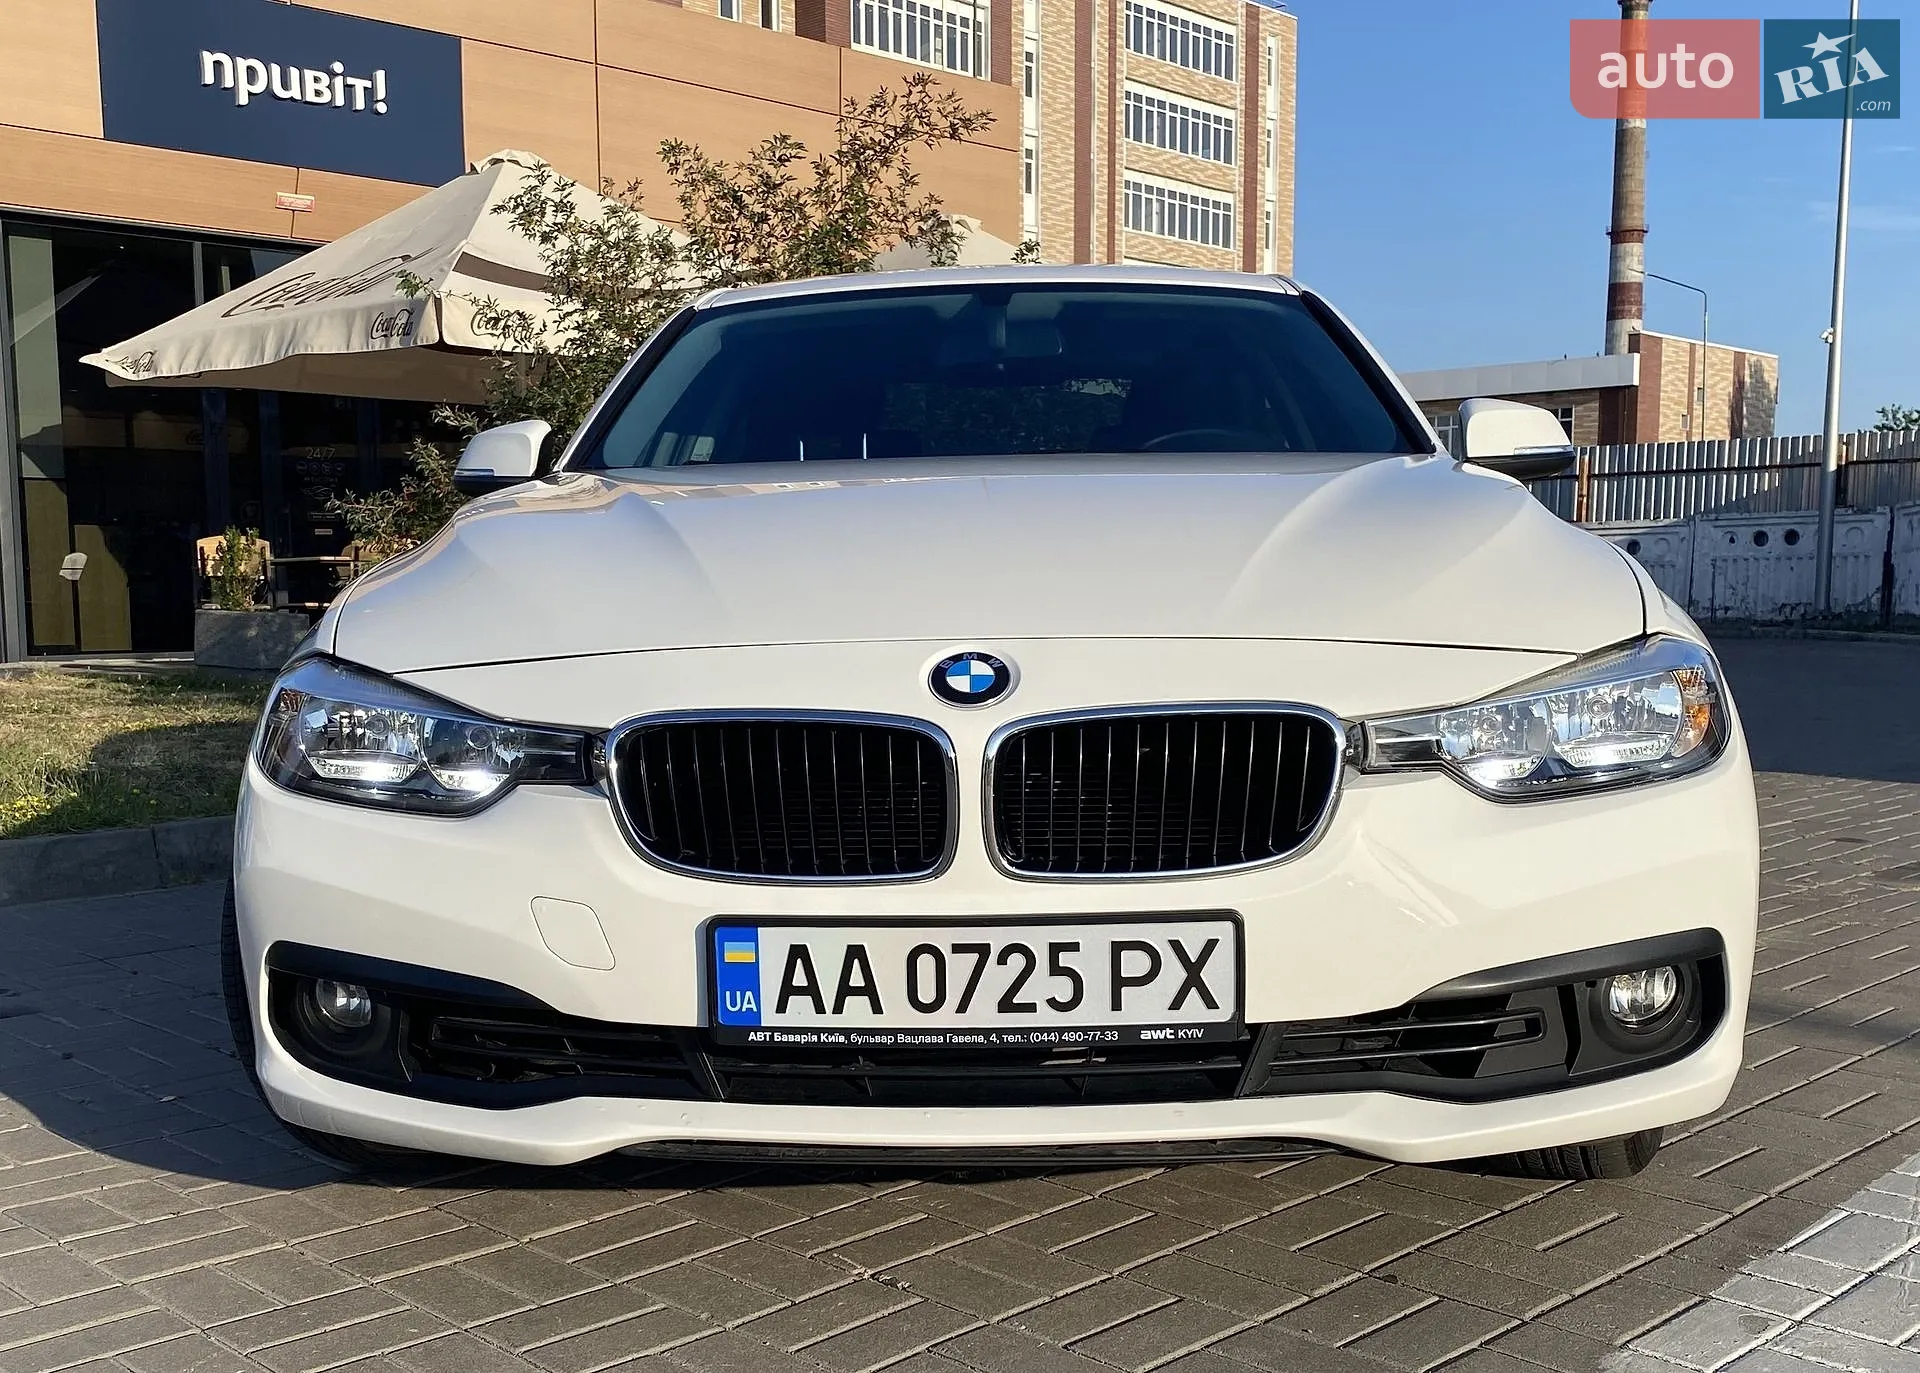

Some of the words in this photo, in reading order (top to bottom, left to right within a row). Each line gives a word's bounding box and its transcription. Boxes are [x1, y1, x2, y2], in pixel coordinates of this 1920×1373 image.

[201, 50, 388, 115] привіт!
[306, 448, 336, 460] 24/7
[939, 652, 1004, 669] BMW
[774, 943, 884, 1016] AA
[905, 942, 1084, 1015] 0725
[1109, 938, 1221, 1012] PX
[725, 990, 757, 1013] UA
[748, 1031, 771, 1042] АВТ
[774, 1032, 817, 1044] Баварія
[820, 1032, 848, 1043] Київ,
[850, 1032, 894, 1044] бульвар
[897, 1032, 943, 1044] Вацлава
[946, 1032, 987, 1044] Гавела,
[989, 1032, 1000, 1043] 4,
[1002, 1034, 1027, 1043] тел.:
[1030, 1031, 1059, 1043] (044)
[1061, 1031, 1119, 1042] 490-77-33
[1140, 1028, 1175, 1040] awt
[1178, 1028, 1204, 1039] KYIV
